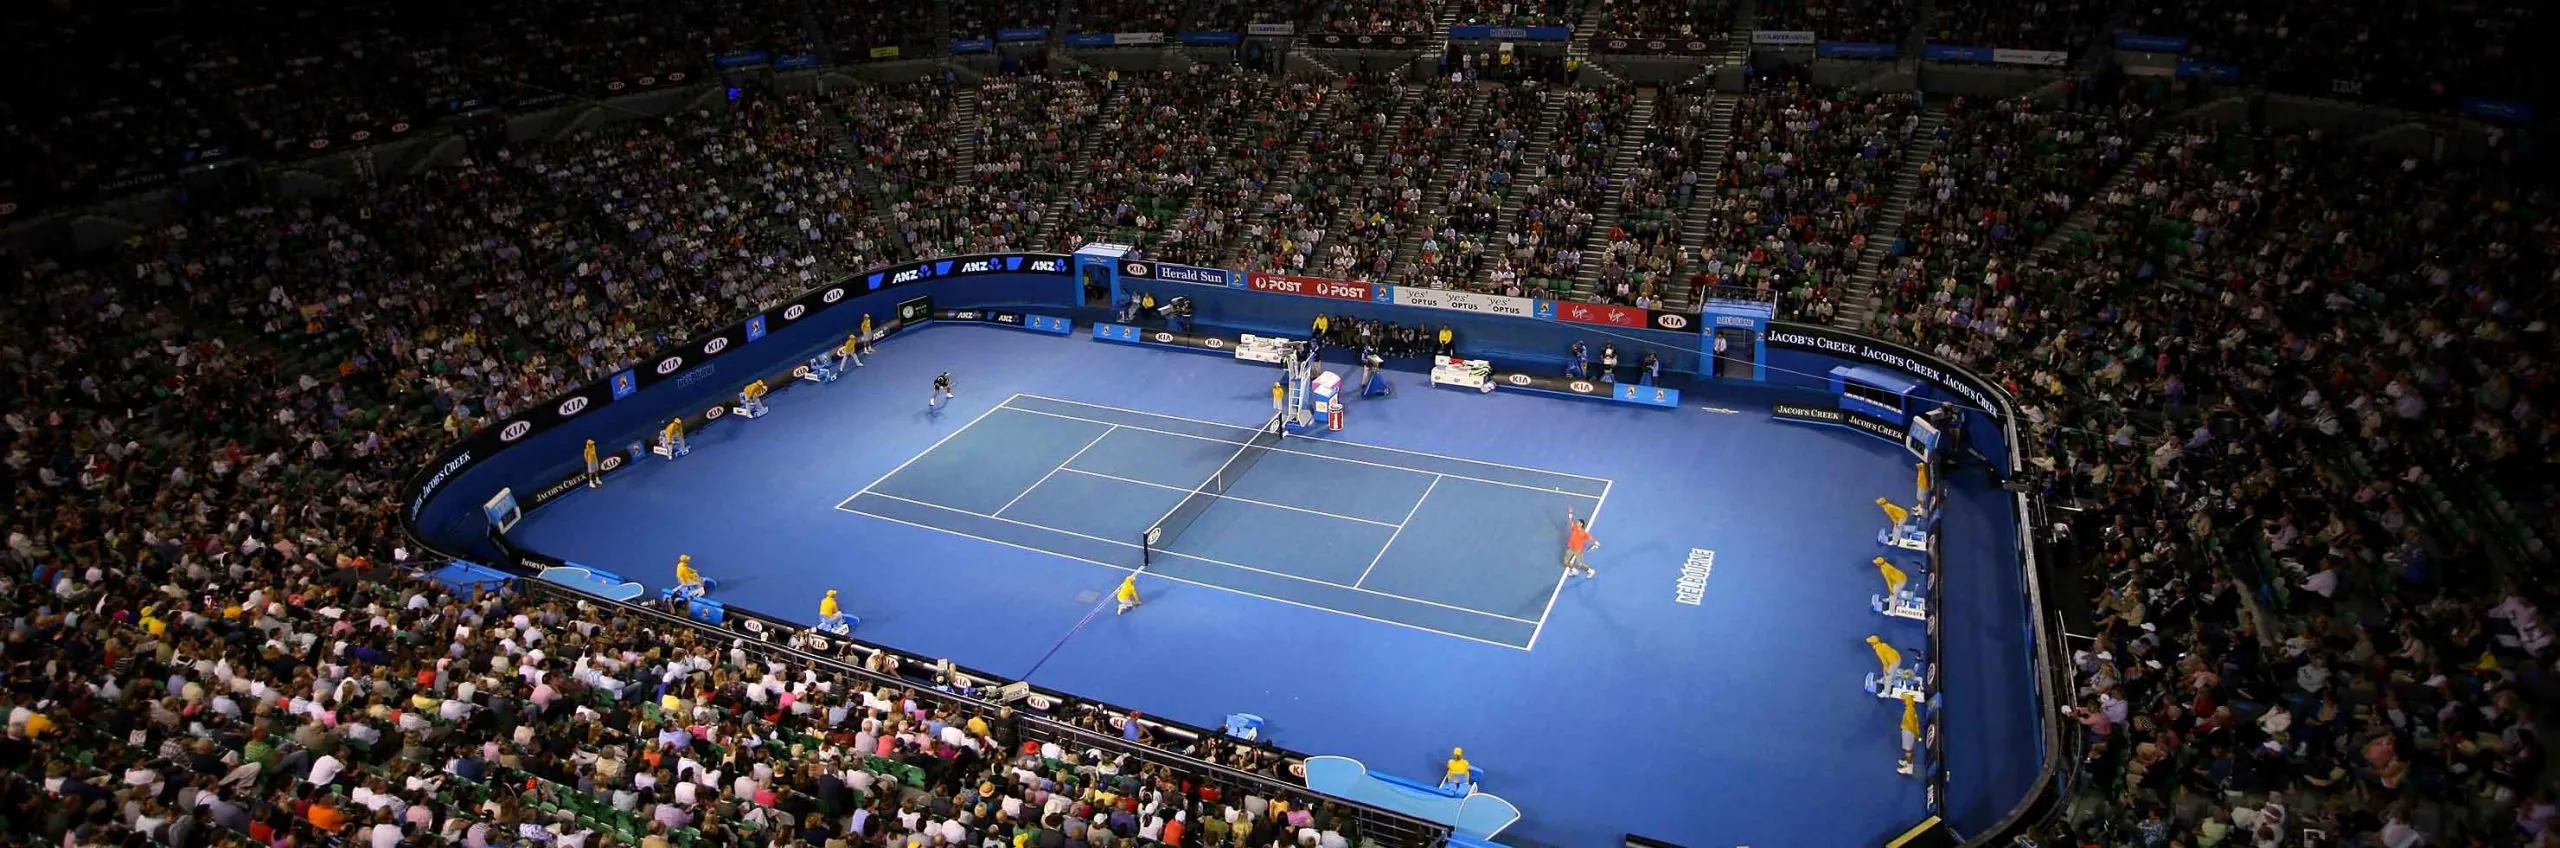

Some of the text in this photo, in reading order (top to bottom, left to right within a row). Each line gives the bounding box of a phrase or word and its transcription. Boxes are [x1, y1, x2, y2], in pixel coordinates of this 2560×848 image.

[961, 261, 989, 273] ANZ
[1030, 260, 1056, 272] ANZ
[1130, 263, 1147, 276] KIA
[892, 269, 919, 284] ANZ
[1161, 268, 1222, 284] Herald Sun
[1269, 280, 1302, 293] POST
[1331, 285, 1365, 299] POST
[827, 289, 844, 303] KIA
[1411, 298, 1437, 307] OPTUS
[787, 305, 804, 319] KIA
[1451, 301, 1478, 311] OPTUS
[1492, 306, 1520, 315] OPTUS
[957, 311, 974, 320] ANZ
[998, 314, 1014, 323] ANZ
[1661, 315, 1686, 328] KIA
[1158, 332, 1174, 342] KIA
[1206, 338, 1222, 349] KIA
[1768, 330, 1857, 355] JACOB'S CREEK
[708, 339, 727, 354] KIA
[660, 358, 680, 373] KIA
[1861, 345, 1940, 384] JACOB'S CREEK
[1512, 374, 1529, 385] KIA
[1573, 381, 1591, 392] KIA
[1943, 373, 1999, 421] JACOB'S CREEK
[561, 398, 586, 415] KIA
[708, 407, 723, 418] KIA
[1777, 405, 1840, 421] JACOB'S CREEK
[504, 422, 528, 440] KIA
[1848, 415, 1878, 432] JACOB'S
[1877, 424, 1904, 440] CREEK
[443, 450, 471, 477] CREEK
[603, 458, 619, 469] KIA
[1675, 547, 1716, 606] MELBOURNE
[747, 620, 761, 631] KIA
[1029, 695, 1048, 708] KIA
